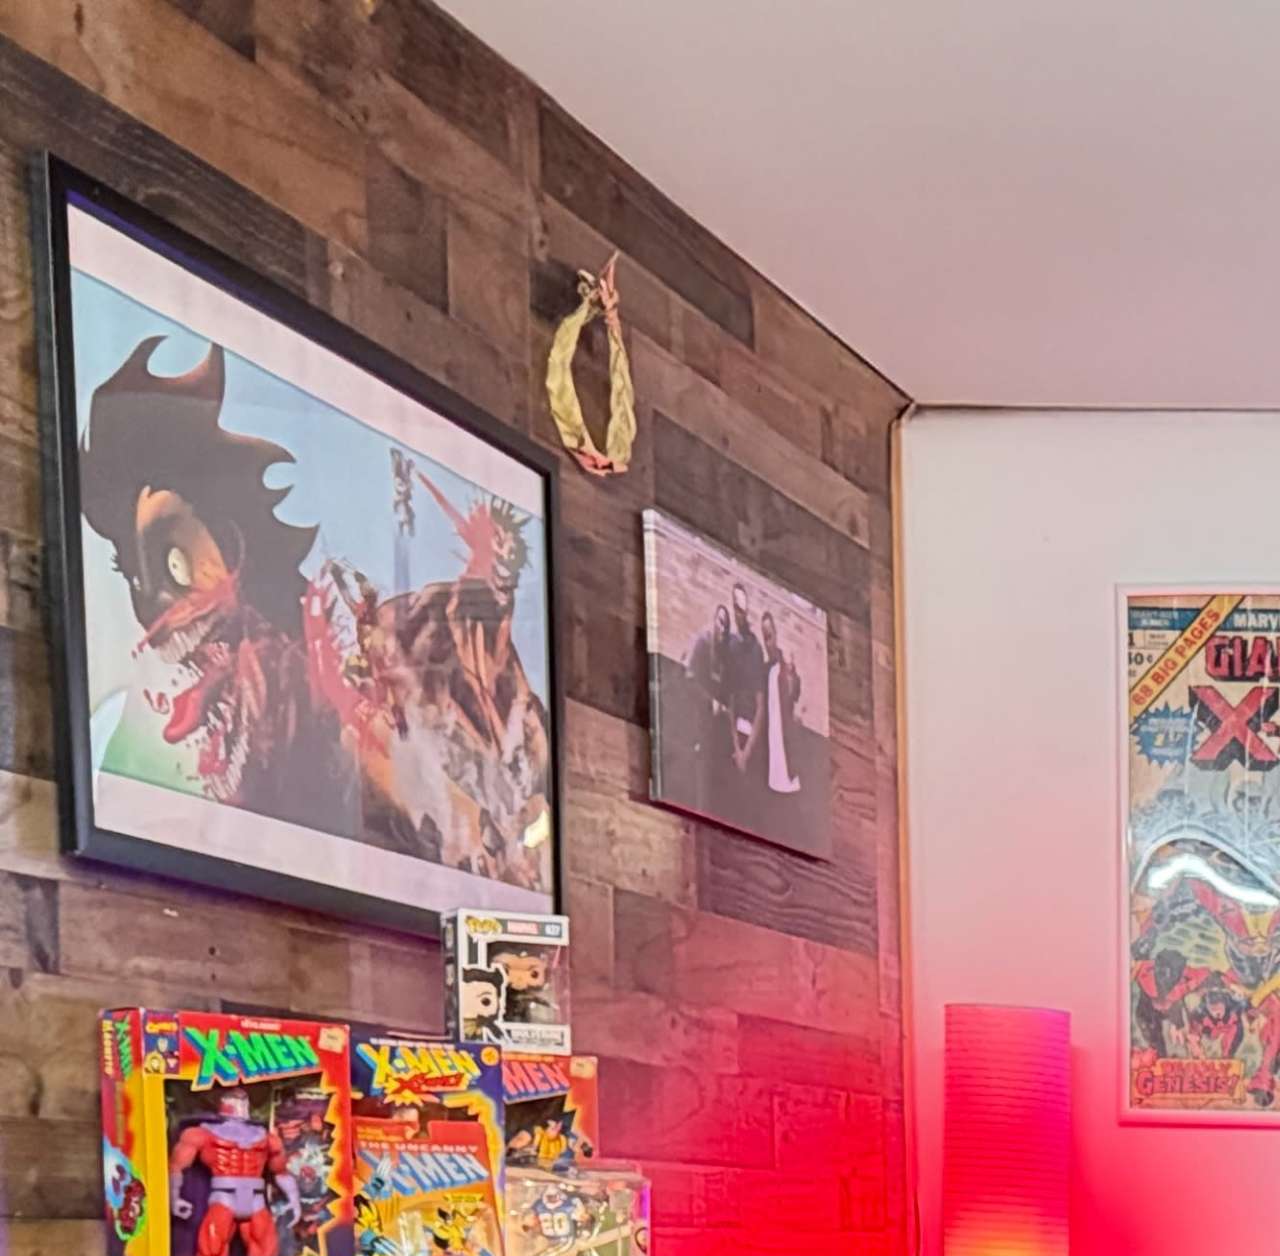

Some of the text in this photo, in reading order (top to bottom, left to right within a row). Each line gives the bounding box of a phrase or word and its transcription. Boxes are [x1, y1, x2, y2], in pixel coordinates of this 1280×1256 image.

[1151, 657, 1178, 685] BIG
[1174, 608, 1221, 658] PAGES
[183, 1026, 319, 1088] X-MEN
[356, 1043, 482, 1096] X-MEN
[358, 1149, 489, 1198] X-MEN
[394, 1142, 479, 1153] UNCANNY
